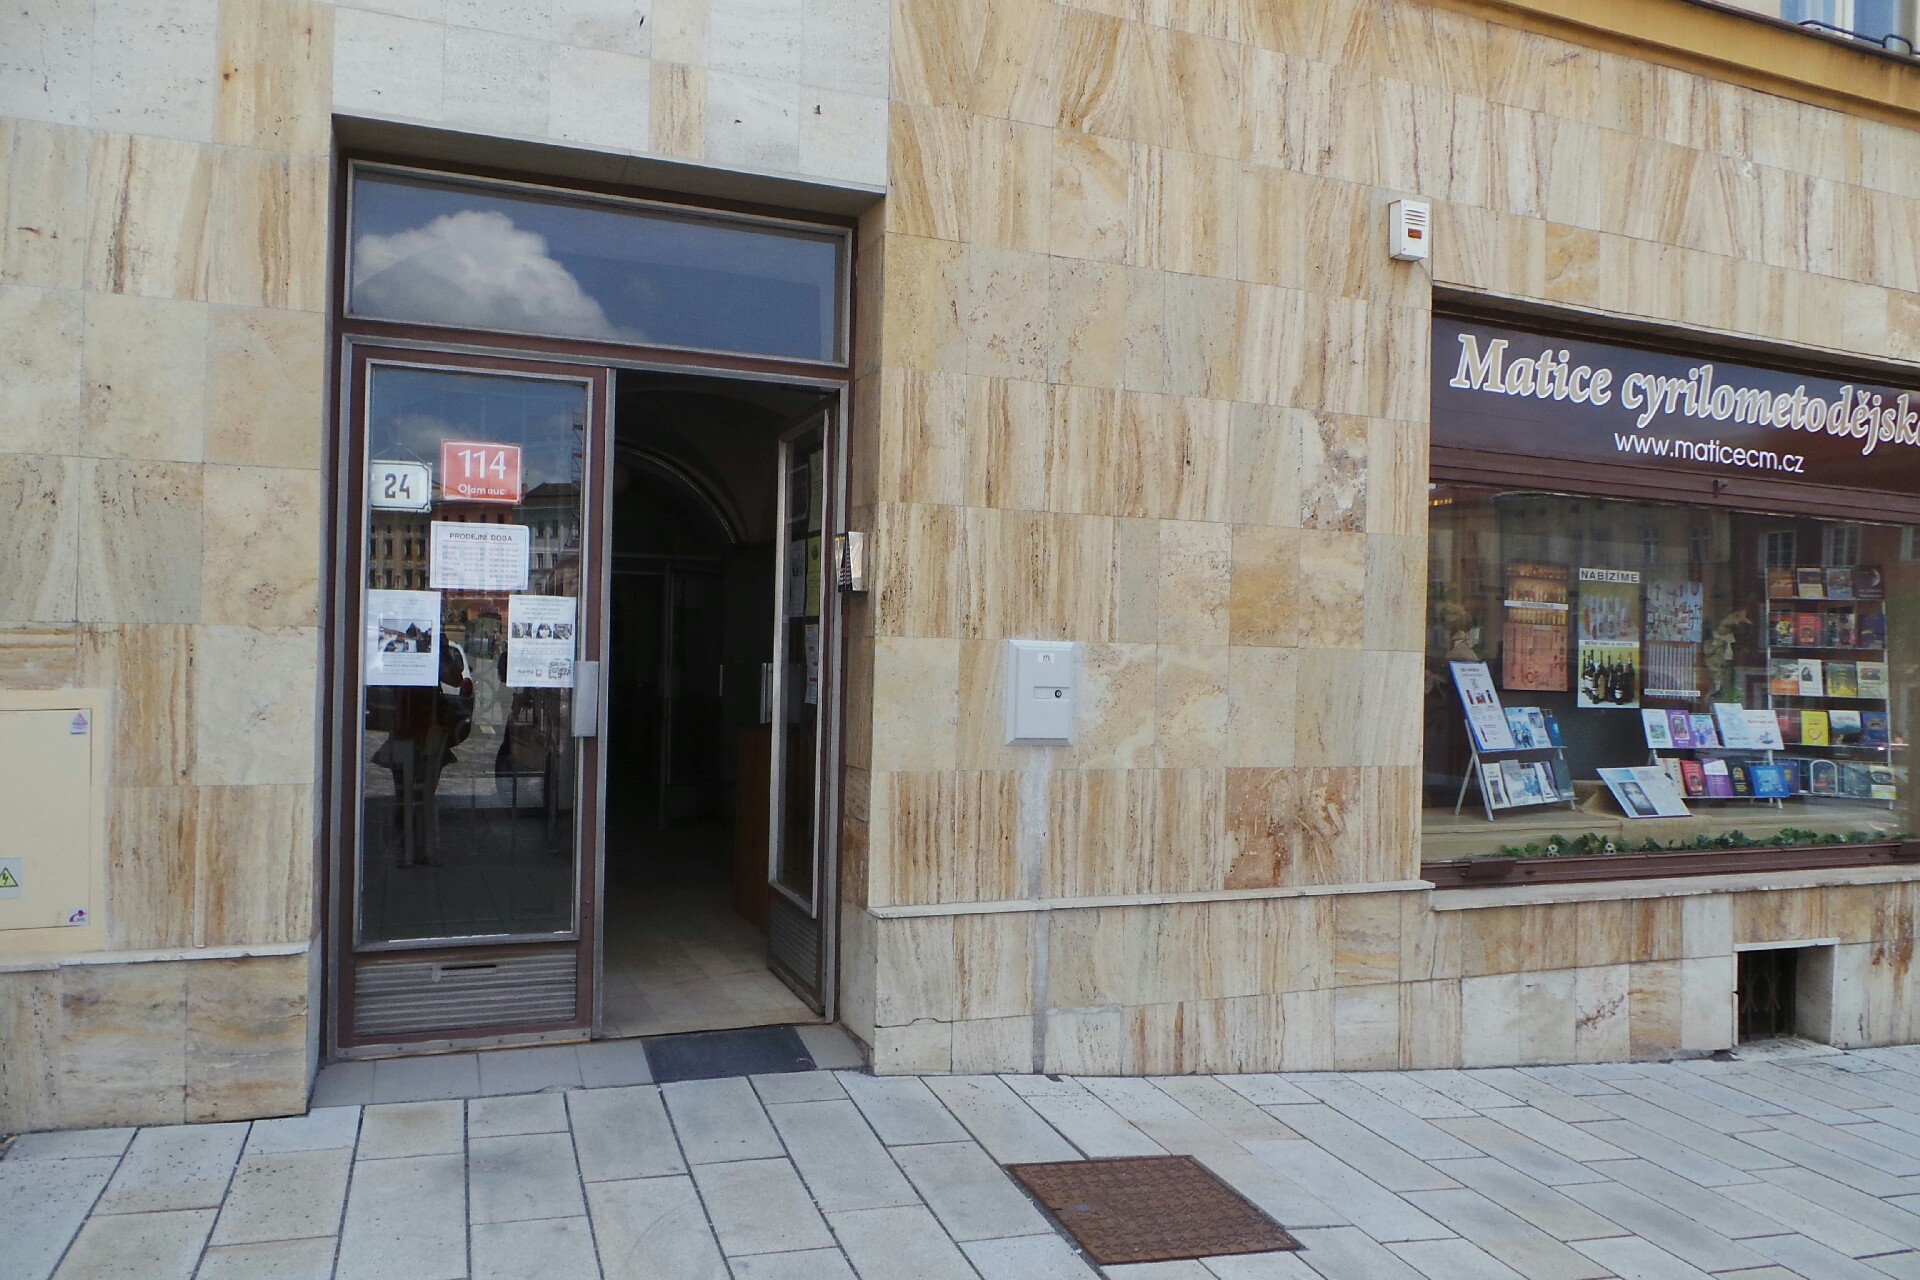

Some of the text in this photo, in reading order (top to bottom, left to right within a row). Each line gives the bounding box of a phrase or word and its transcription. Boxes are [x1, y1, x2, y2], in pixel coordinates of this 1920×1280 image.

[1449, 333, 1920, 455] Matice cyrilometodějsk
[457, 448, 507, 481] 114
[1613, 431, 1806, 474] www.maticecm.cz
[384, 473, 411, 499] 24
[457, 483, 506, 496] Olomouc
[449, 531, 513, 542] PRODEJNÍ DOBA
[1580, 570, 1639, 583] NABÍZÍME
